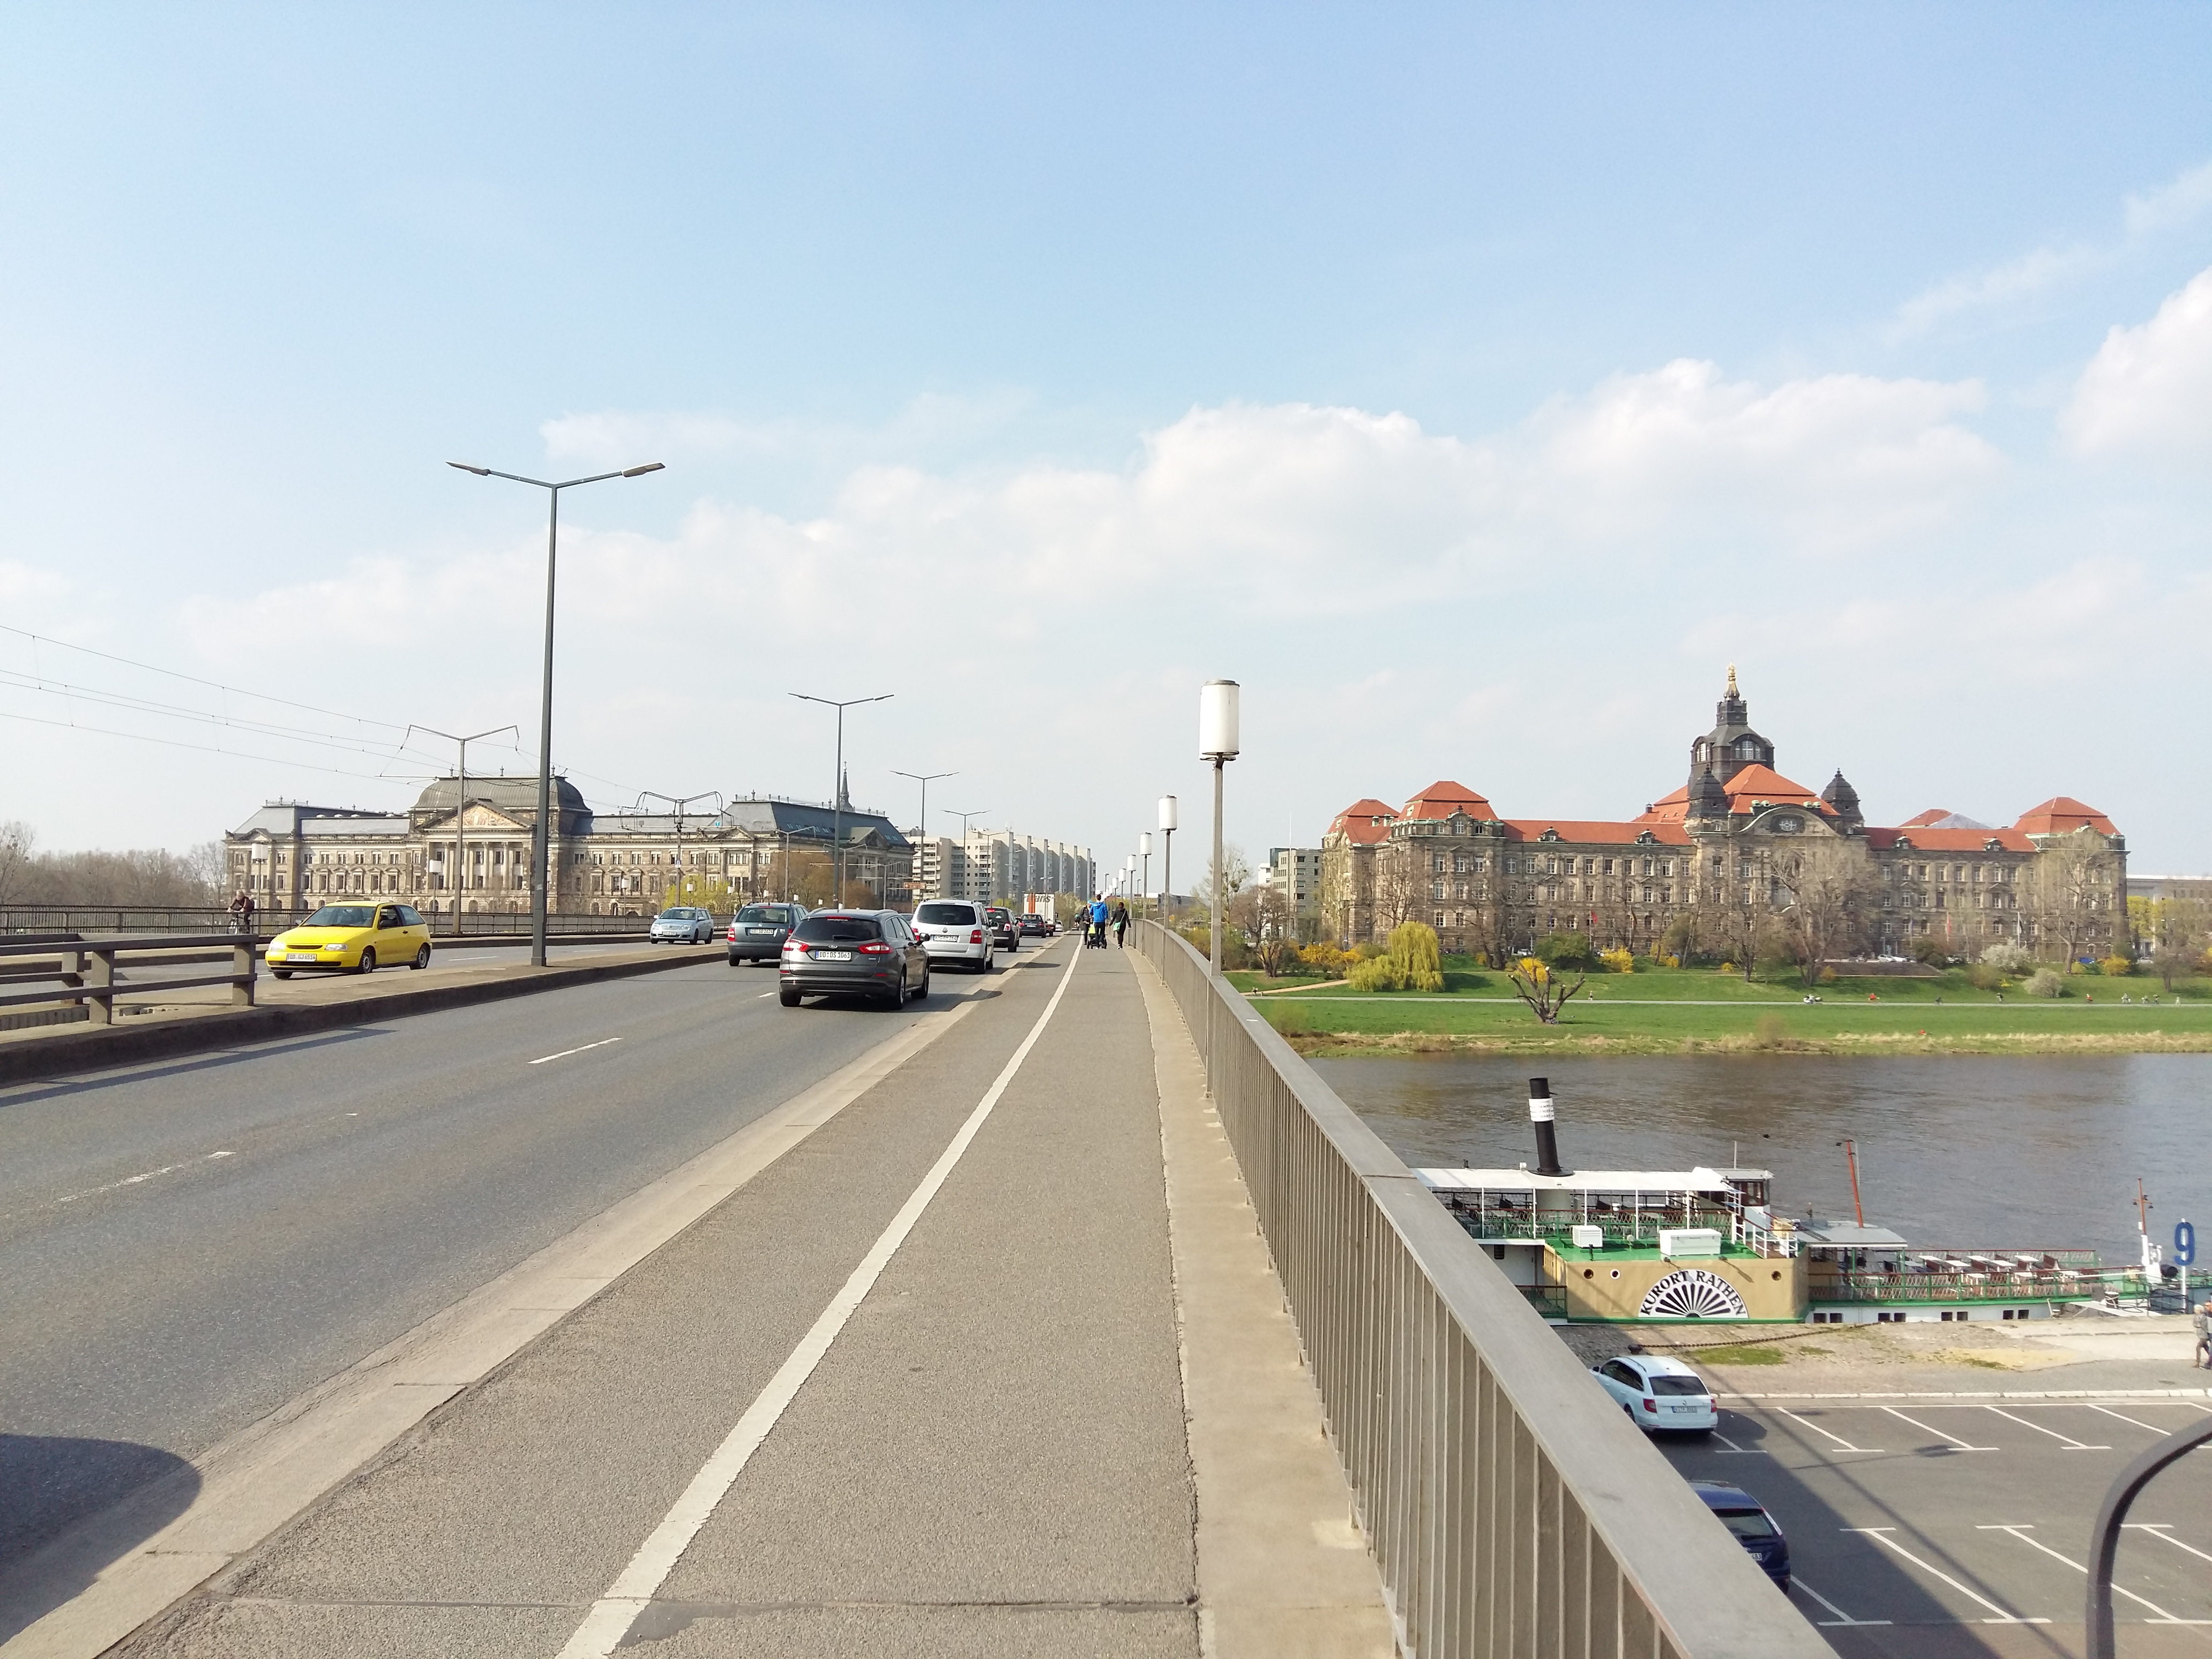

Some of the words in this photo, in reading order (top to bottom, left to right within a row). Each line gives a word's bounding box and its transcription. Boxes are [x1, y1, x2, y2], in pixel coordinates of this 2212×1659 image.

[2173, 1221, 2195, 1266] 9
[1640, 1271, 1688, 1316] KURORT
[1695, 1270, 1746, 1316] RATHEN
